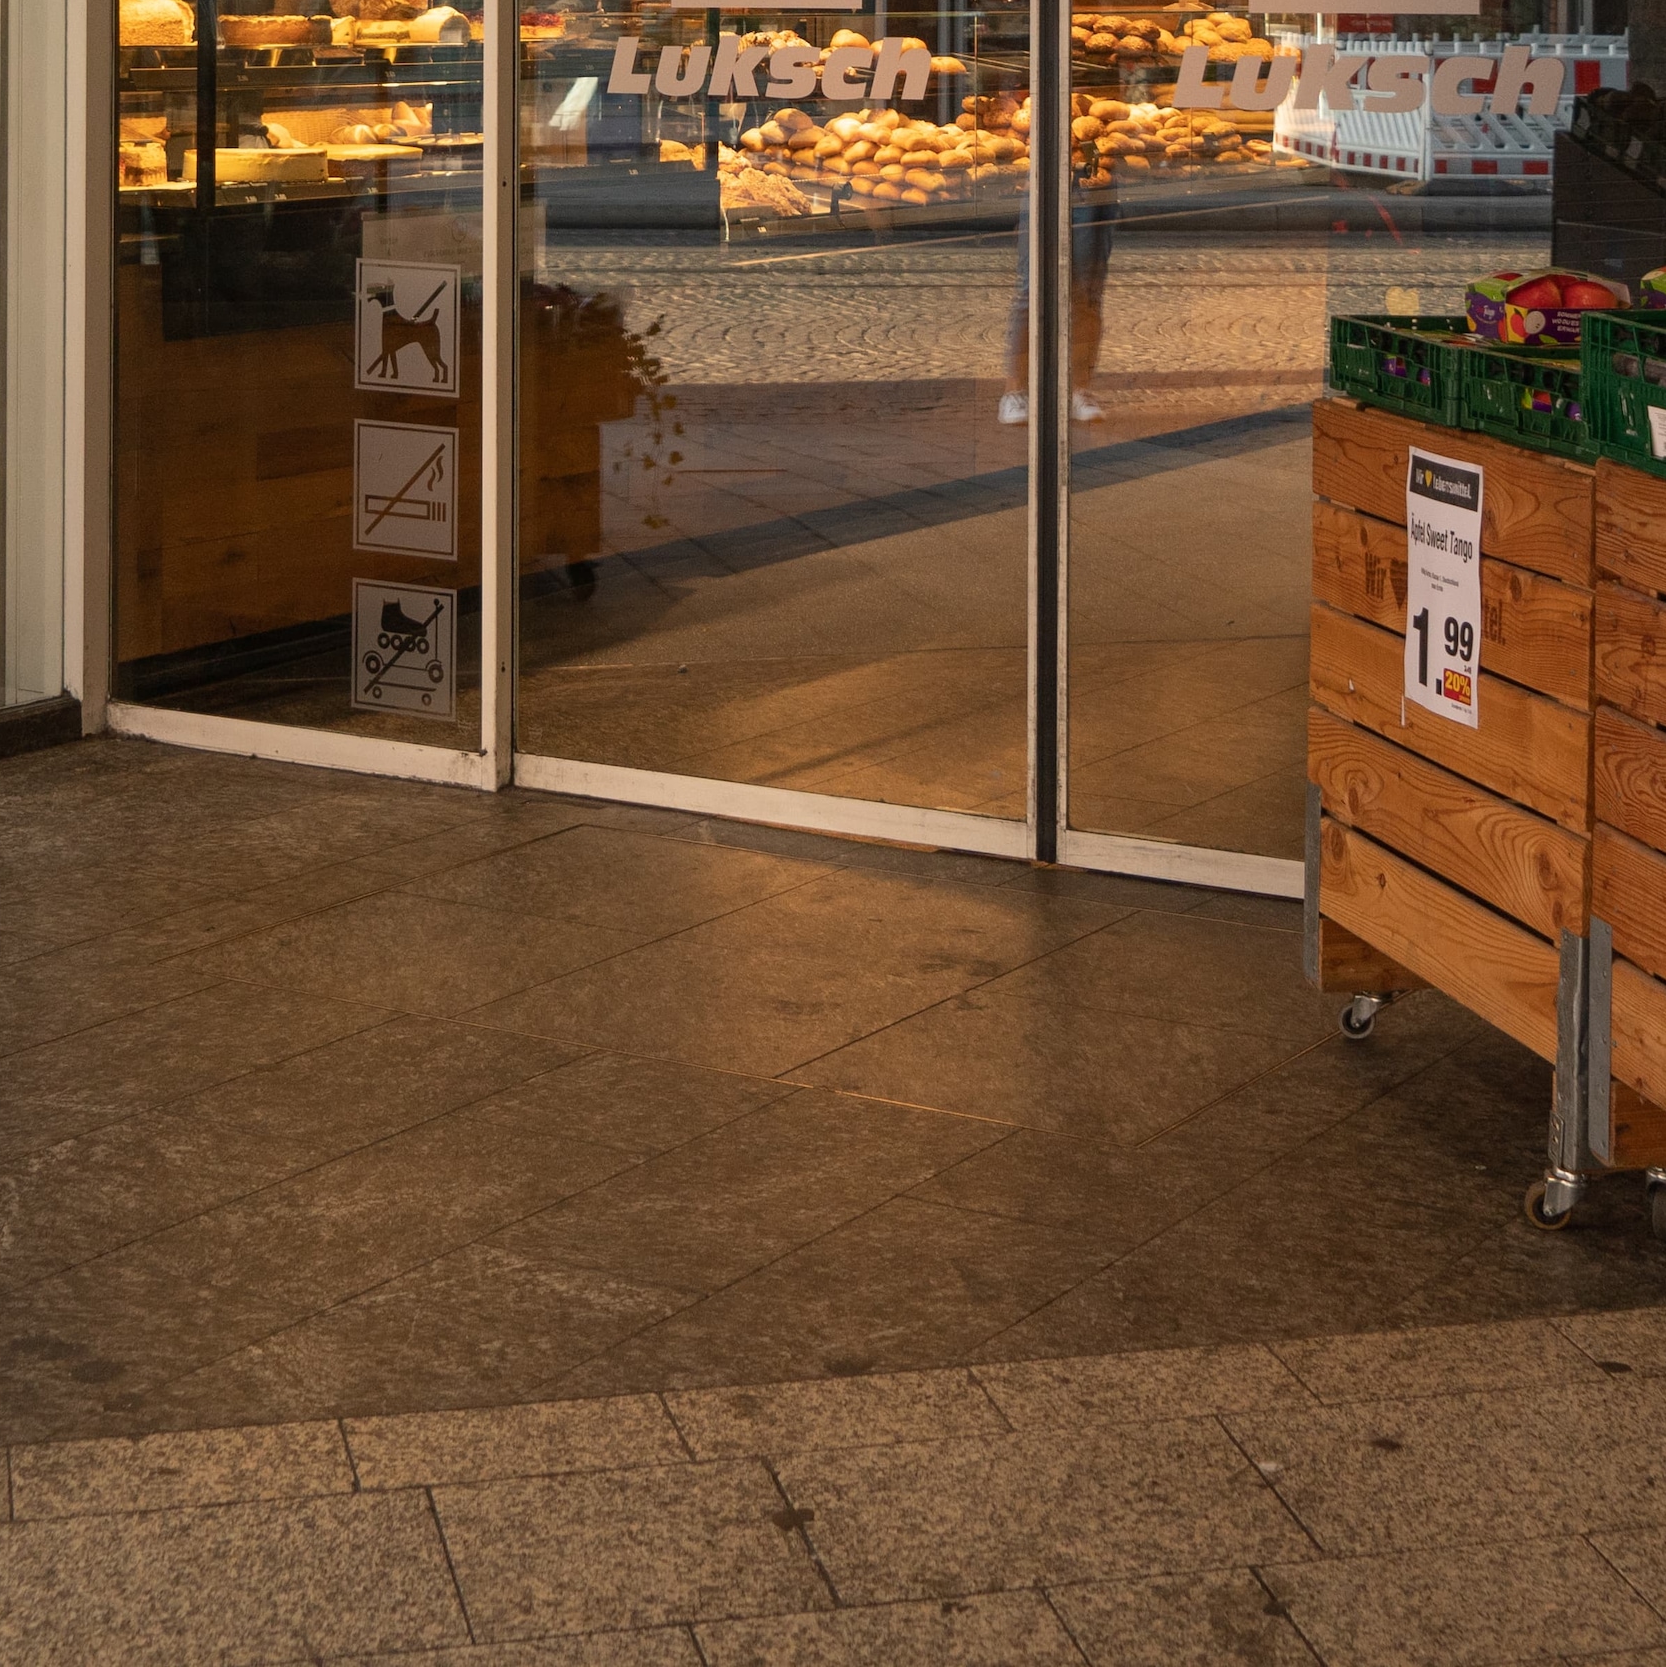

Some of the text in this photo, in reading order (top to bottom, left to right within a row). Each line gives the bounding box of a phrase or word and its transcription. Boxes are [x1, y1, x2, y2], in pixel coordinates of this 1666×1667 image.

[606, 34, 933, 101] Luksch
[1172, 43, 1566, 116] Luksch
[1415, 467, 1425, 486] Wir
[1410, 512, 1473, 563] Äpfel Sweet Tango
[1444, 669, 1472, 696] 20%
